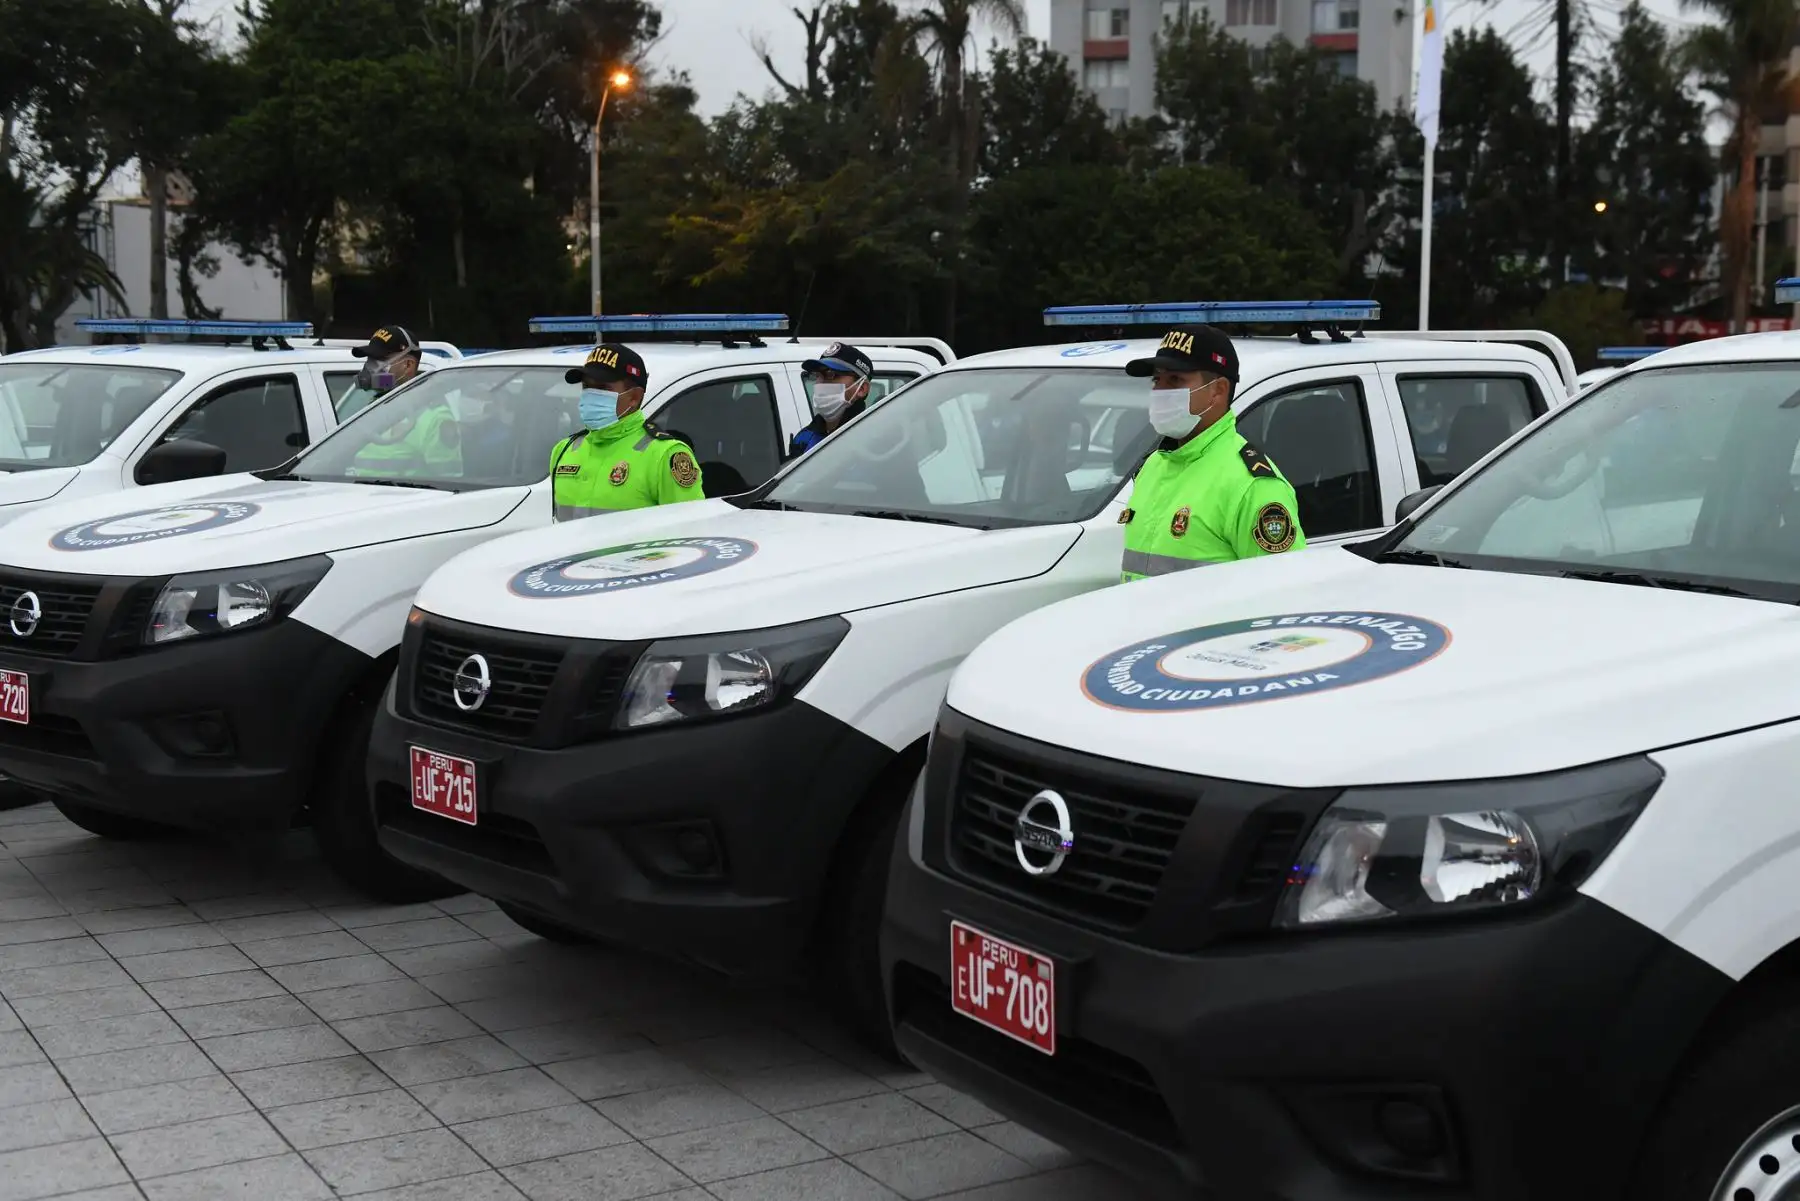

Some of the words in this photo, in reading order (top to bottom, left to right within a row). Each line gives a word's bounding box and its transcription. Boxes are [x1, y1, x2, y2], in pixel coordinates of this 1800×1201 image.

[543, 571, 677, 592] CIUDADANA
[1250, 614, 1426, 652] SERENAZGO
[1107, 643, 1168, 695] SEGURIDAD
[1139, 671, 1341, 702] CIUDADANA
[0, 683, 26, 715] -720
[429, 755, 453, 772] PERU
[422, 765, 473, 813] UF-715
[982, 939, 1018, 968] PERU
[968, 952, 1049, 1035] UF-708
